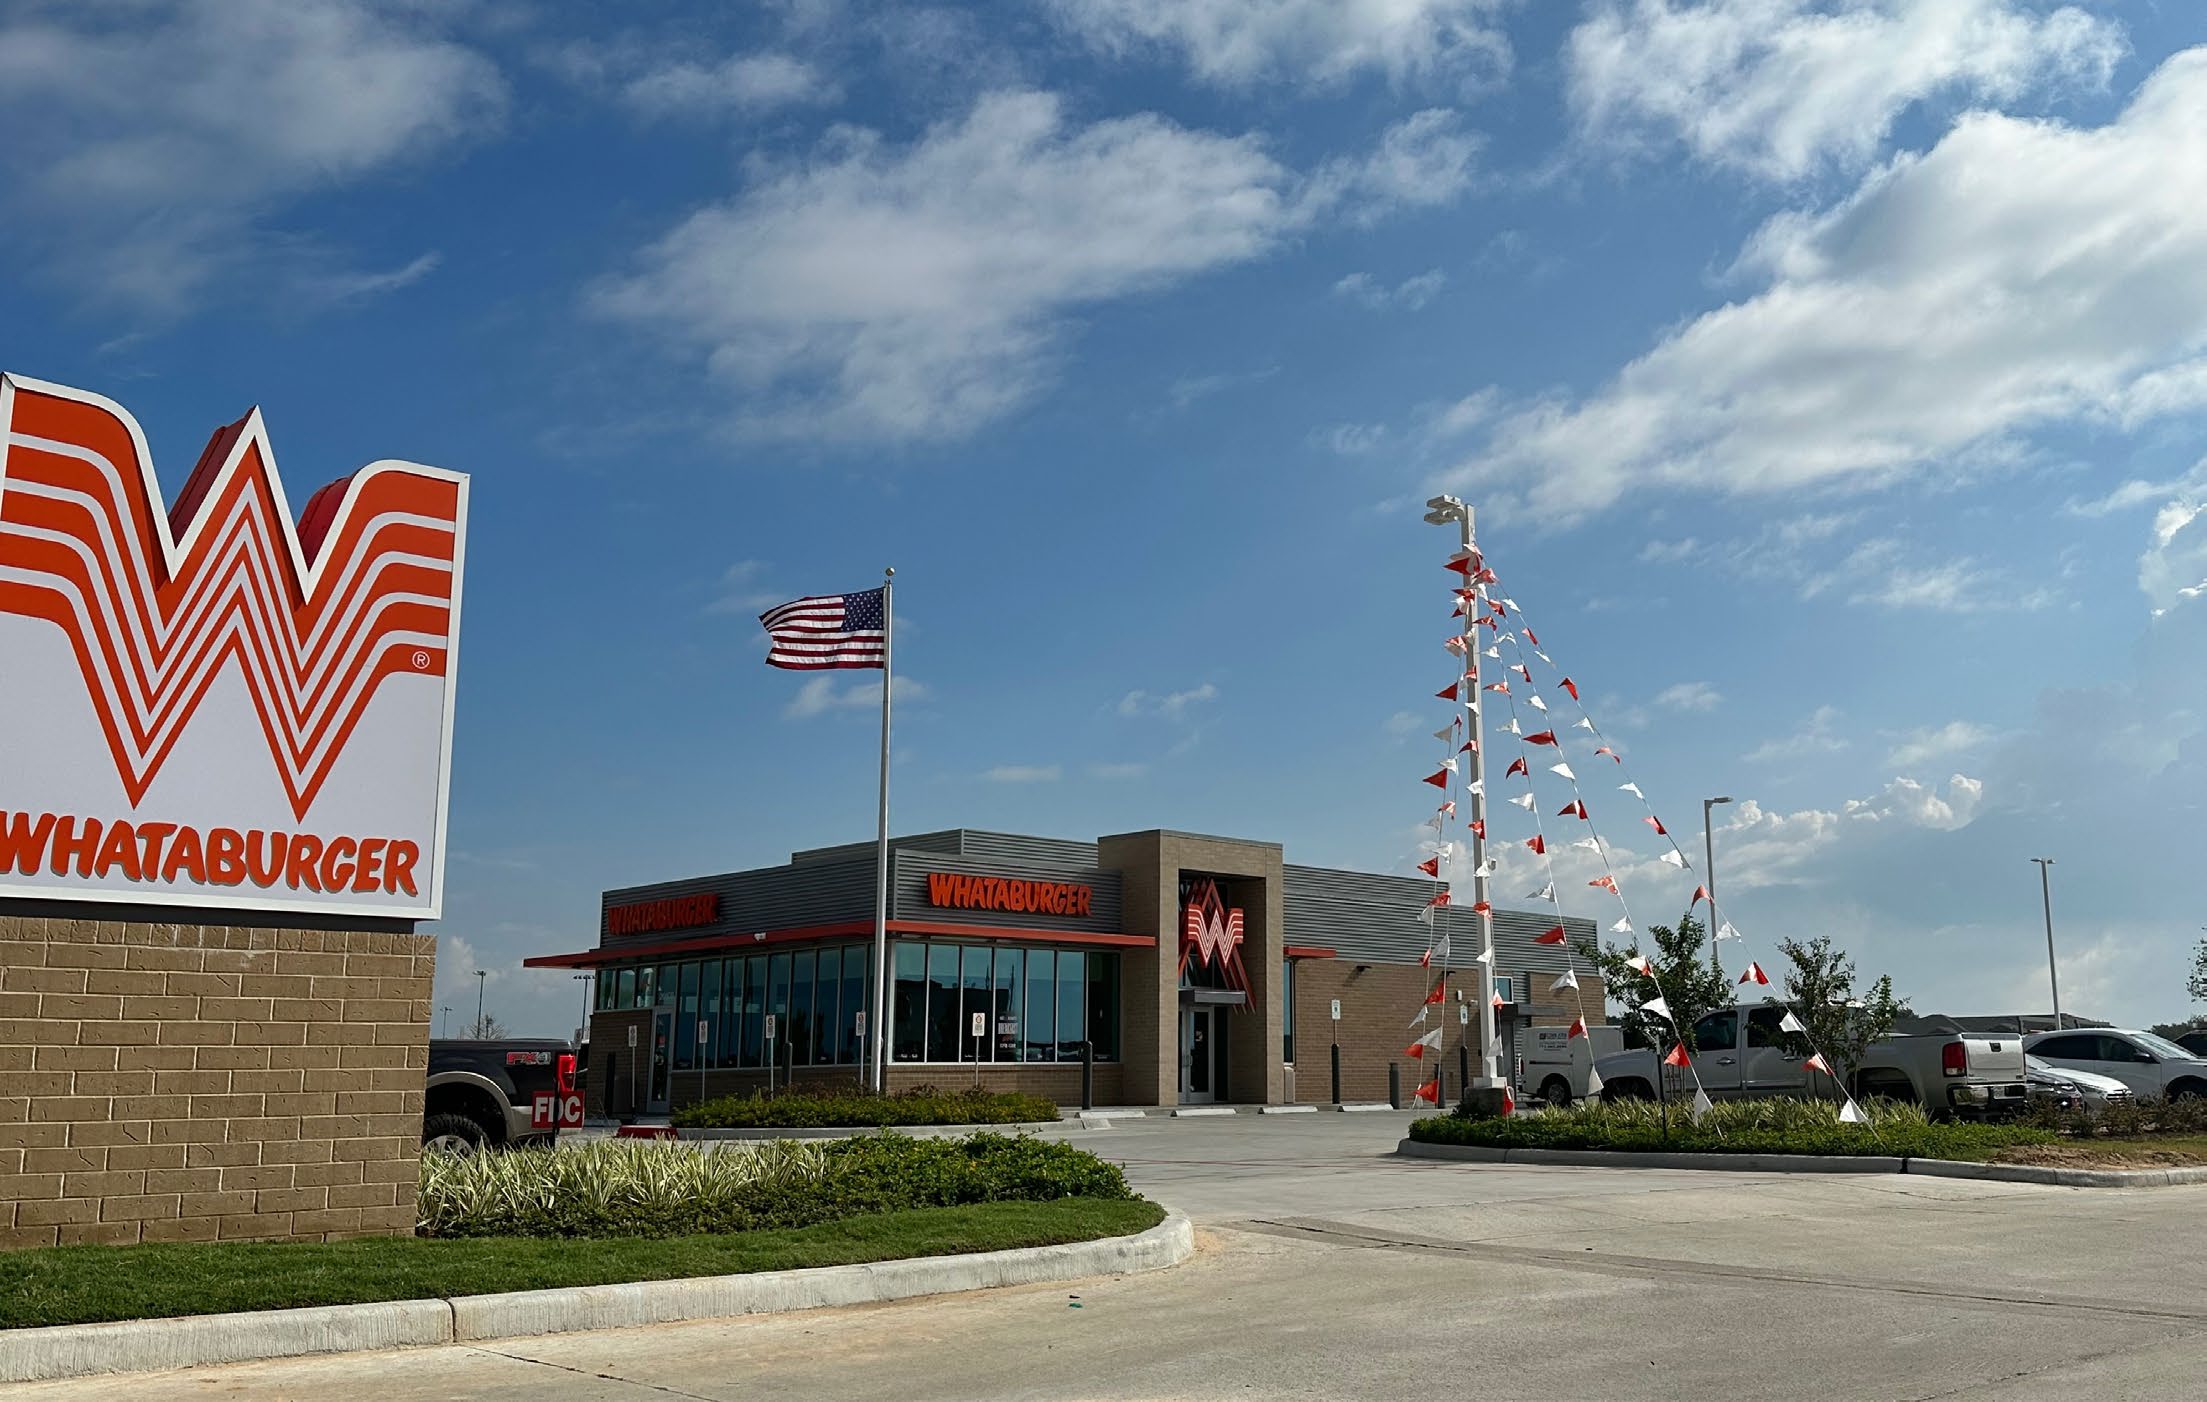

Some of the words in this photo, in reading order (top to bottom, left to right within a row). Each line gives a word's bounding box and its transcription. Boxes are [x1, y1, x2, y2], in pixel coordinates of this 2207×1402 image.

[0, 810, 420, 897] WHATABURGER
[929, 873, 1091, 916] WHATABURGER
[534, 1096, 581, 1123] FDC
